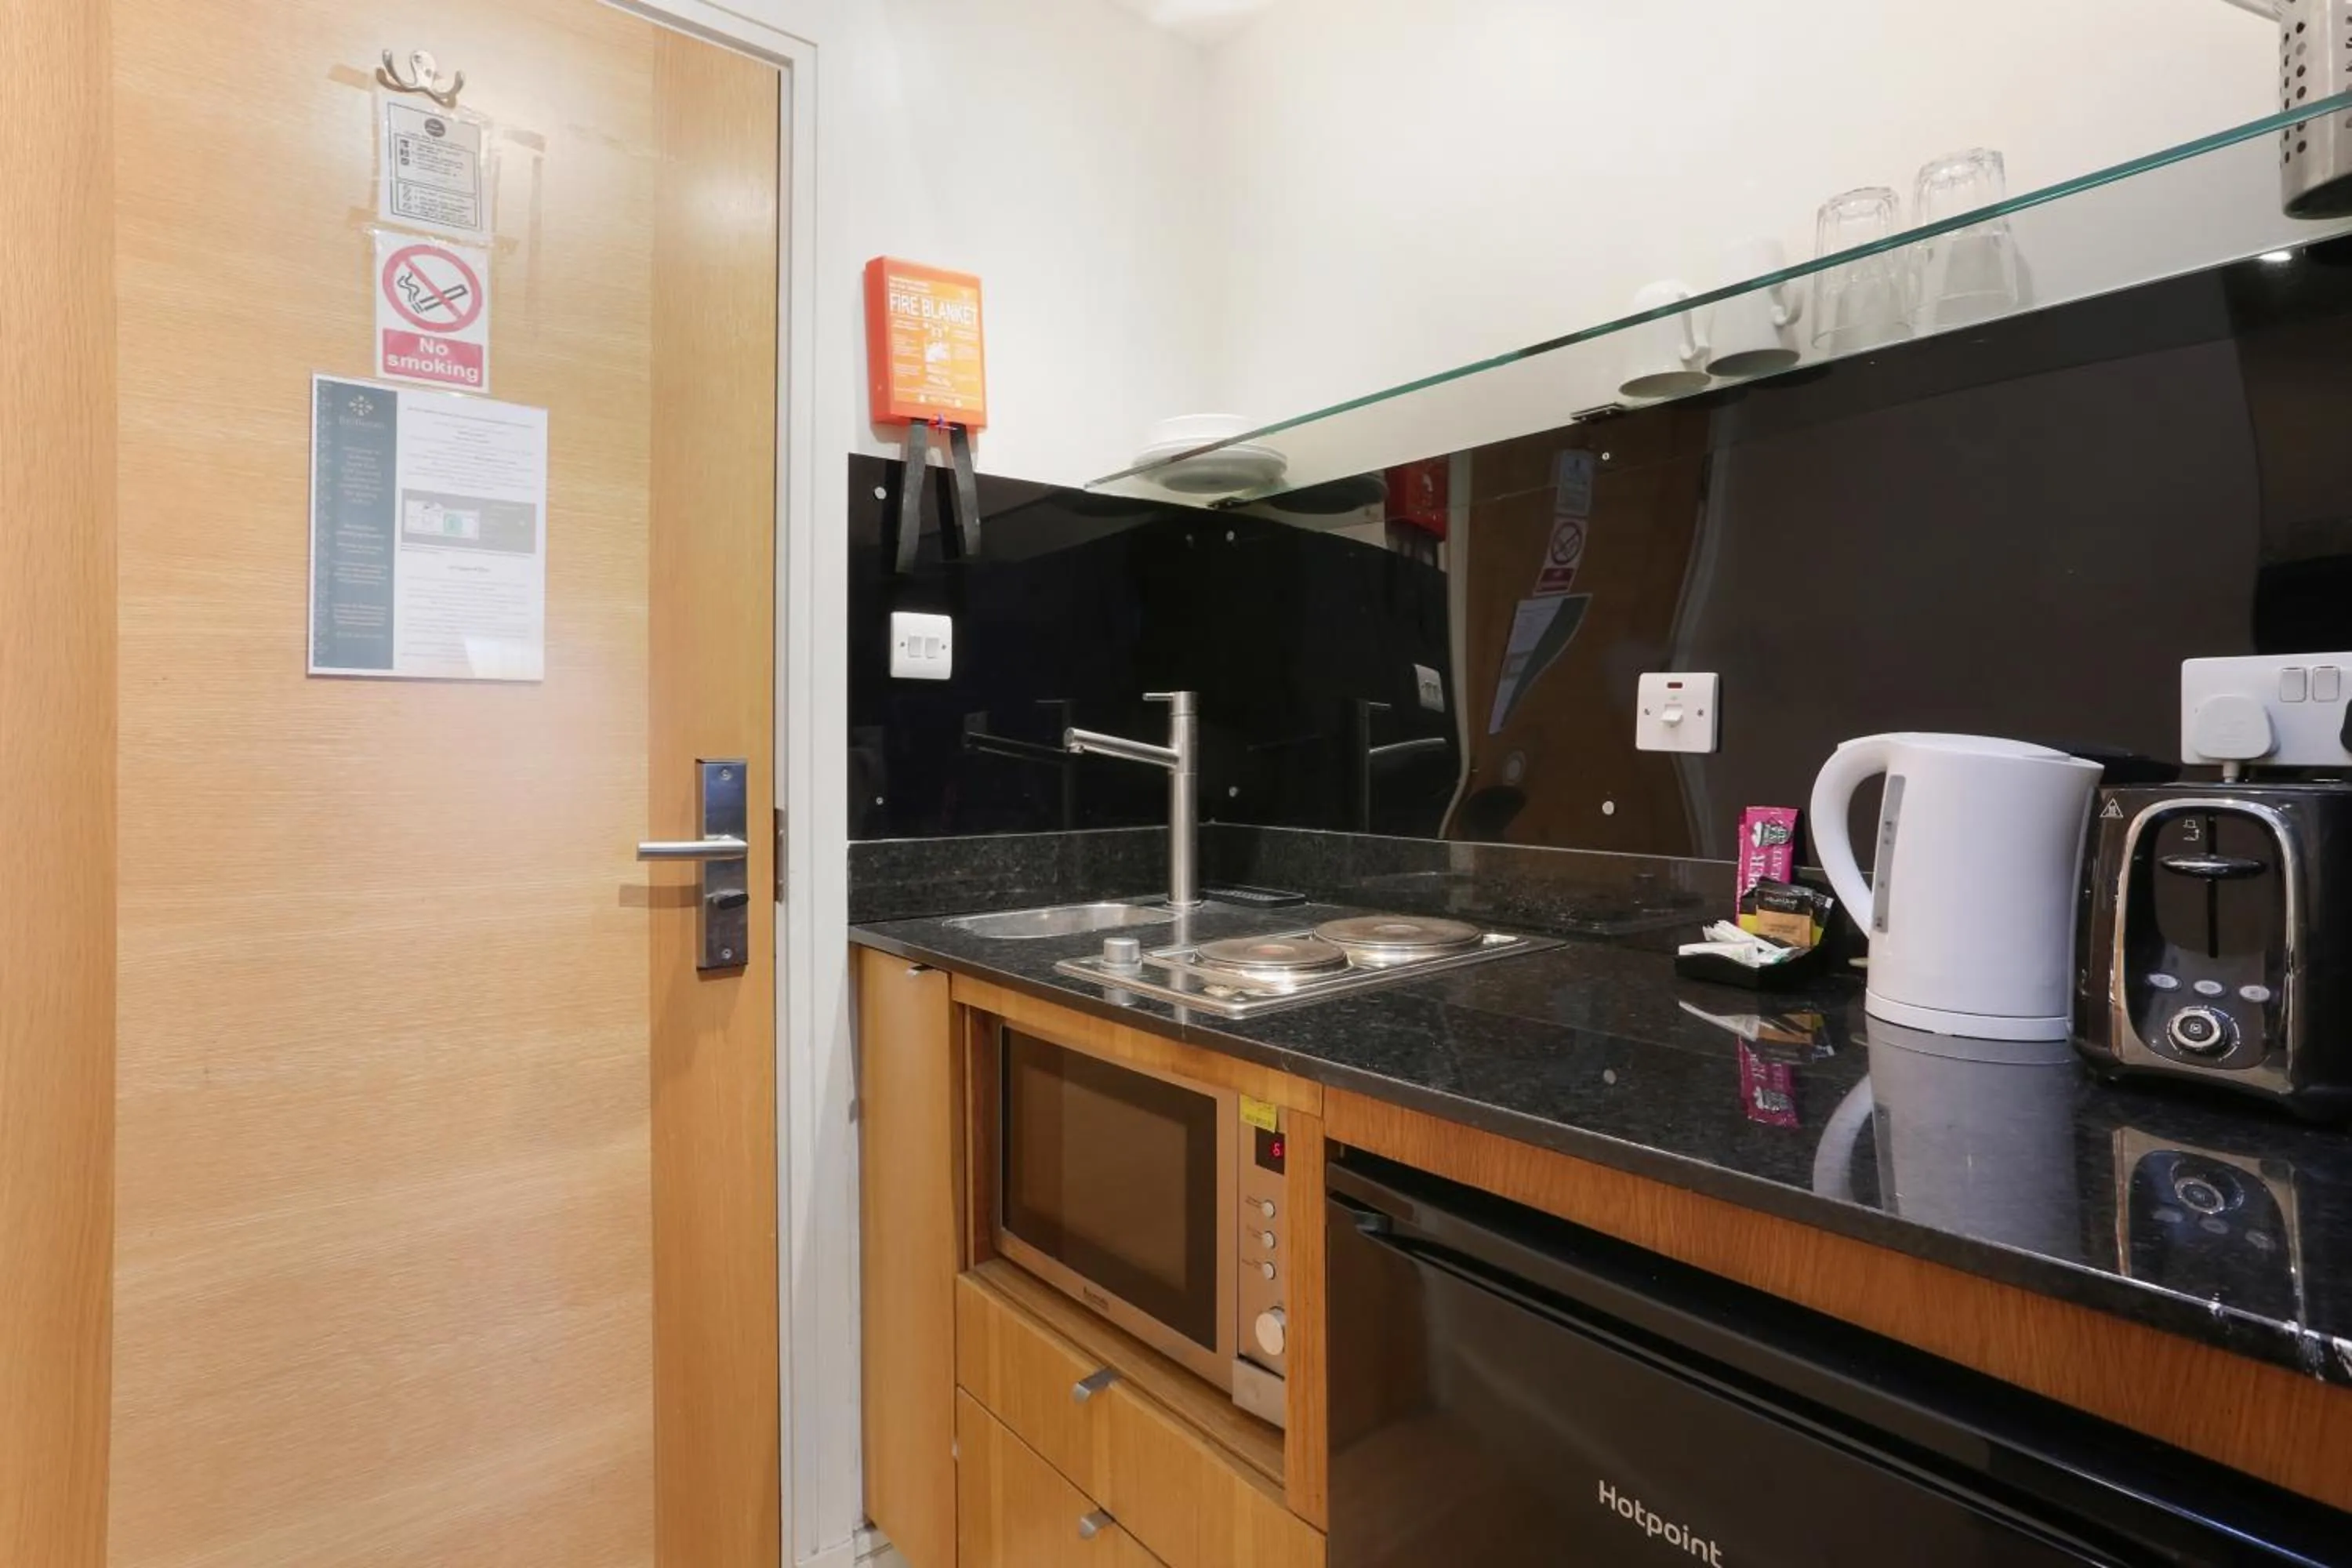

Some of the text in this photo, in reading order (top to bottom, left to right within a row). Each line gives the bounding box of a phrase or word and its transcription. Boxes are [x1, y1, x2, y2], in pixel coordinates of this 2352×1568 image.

[890, 293, 920, 317] FIRE
[922, 297, 977, 326] BLANKET
[419, 338, 449, 356] No
[387, 354, 478, 383] smoking
[1744, 852, 1766, 893] PER
[1598, 1479, 1722, 1568] Hotpoint
